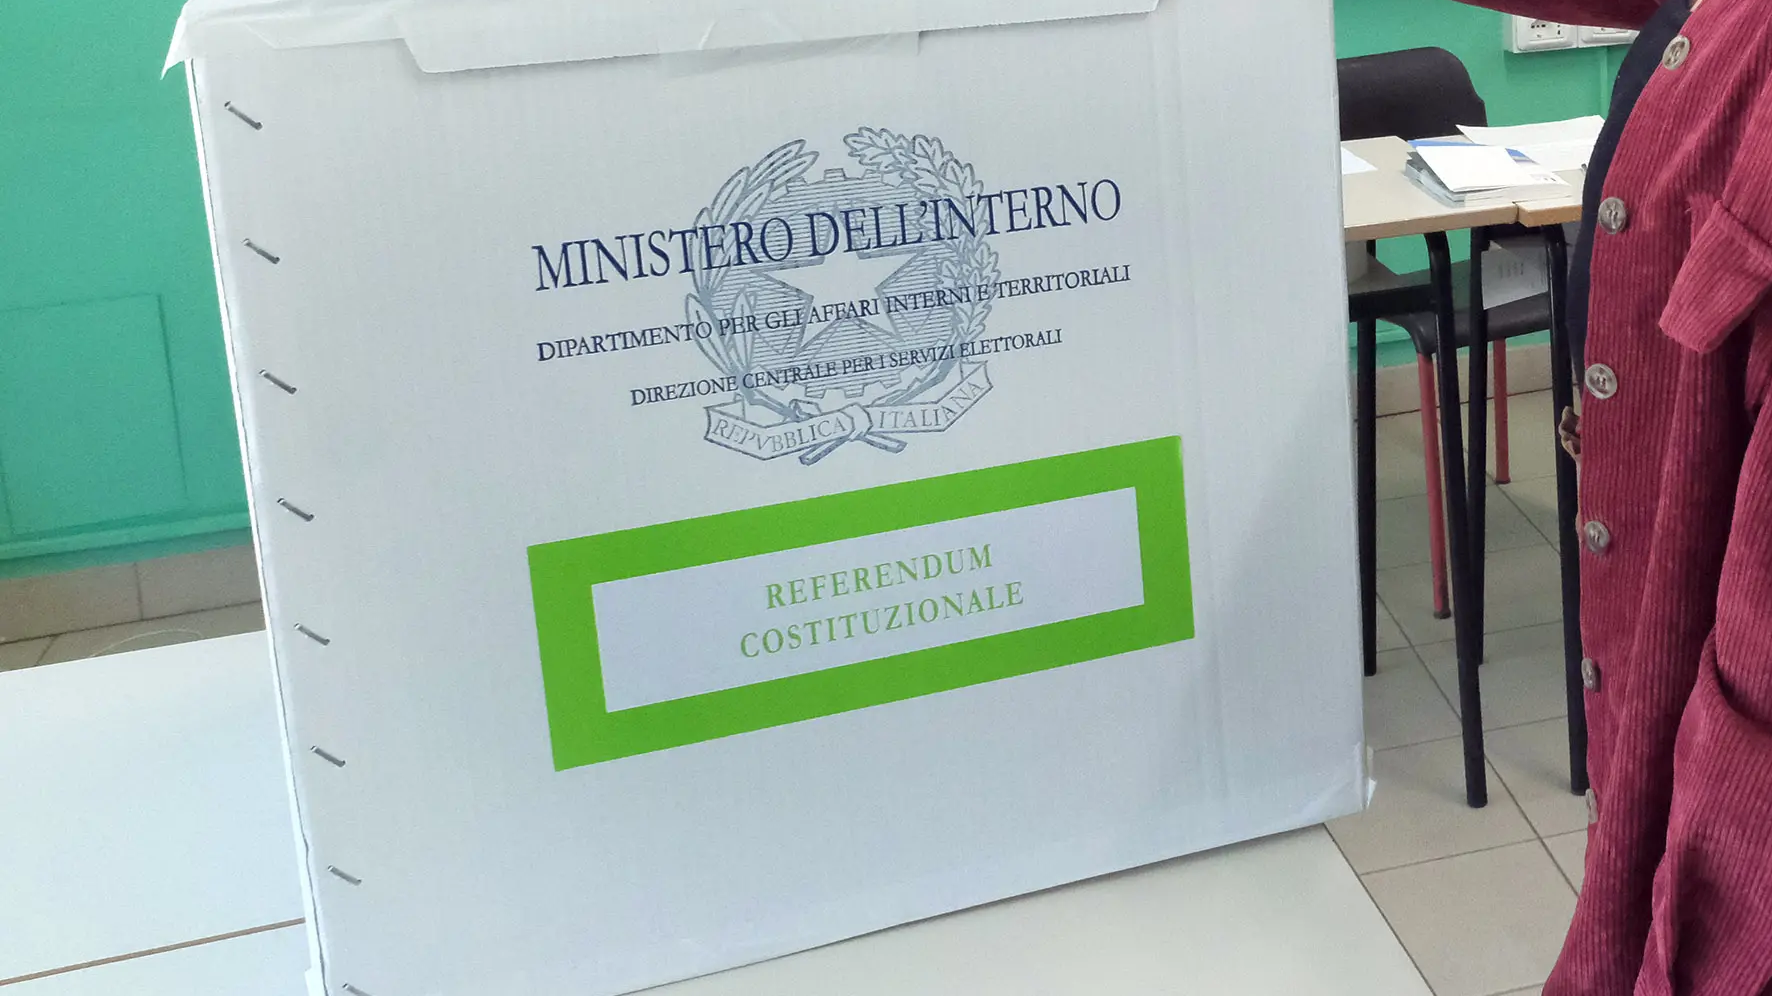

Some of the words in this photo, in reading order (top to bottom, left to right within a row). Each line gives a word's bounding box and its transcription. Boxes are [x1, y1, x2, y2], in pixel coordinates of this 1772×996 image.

[532, 215, 796, 291] MINISTERO
[806, 177, 1122, 258] DELL'INTERNO
[536, 318, 713, 362] DIPARTIMENTO
[719, 308, 760, 338] PER
[765, 302, 805, 332] GLI
[808, 296, 881, 324] AFFARI
[885, 284, 972, 315] INTERNI
[976, 282, 991, 302] E
[993, 263, 1132, 300] TERRITORIALI
[630, 372, 740, 406] DIREZIONE
[742, 360, 838, 391] CENTRALE
[842, 353, 875, 377] PER
[878, 353, 887, 370] I
[889, 342, 956, 370] SERVIZI
[959, 327, 1063, 360] ELETTORALI
[877, 377, 986, 431] ITALIANA
[766, 542, 994, 610] REFERENDUM
[740, 581, 1025, 659] COSTITUZIONALE
